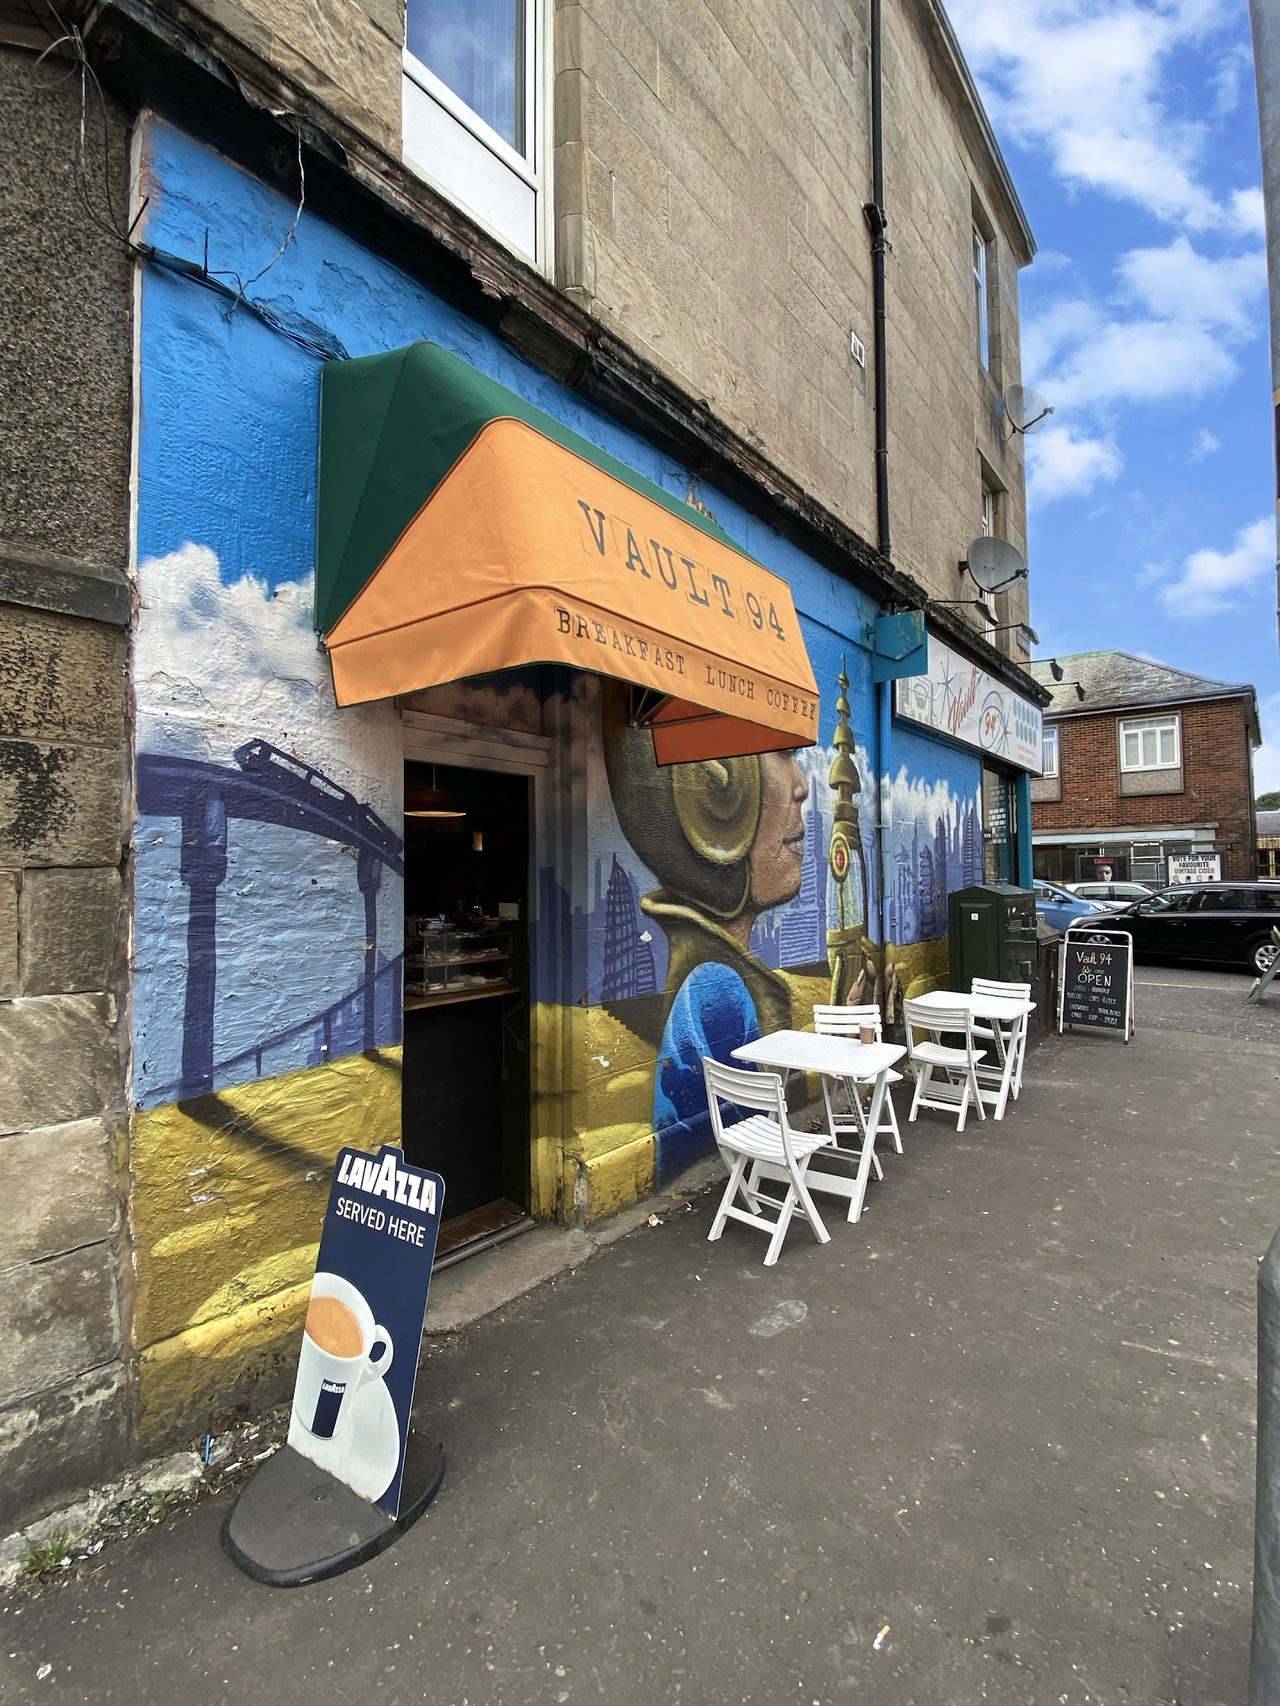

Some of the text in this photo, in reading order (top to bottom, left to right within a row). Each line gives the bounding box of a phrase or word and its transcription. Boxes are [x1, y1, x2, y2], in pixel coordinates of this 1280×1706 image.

[577, 499, 786, 641] VAULT 94
[556, 607, 817, 721] BREAKFAST LUNCH COFFEE
[947, 666, 997, 740] Vault 94
[1076, 951, 1112, 965] Vault 94
[1077, 973, 1112, 986] OPEN
[336, 1153, 437, 1216] LAVAZZA
[335, 1196, 426, 1248] SERVED HERE
